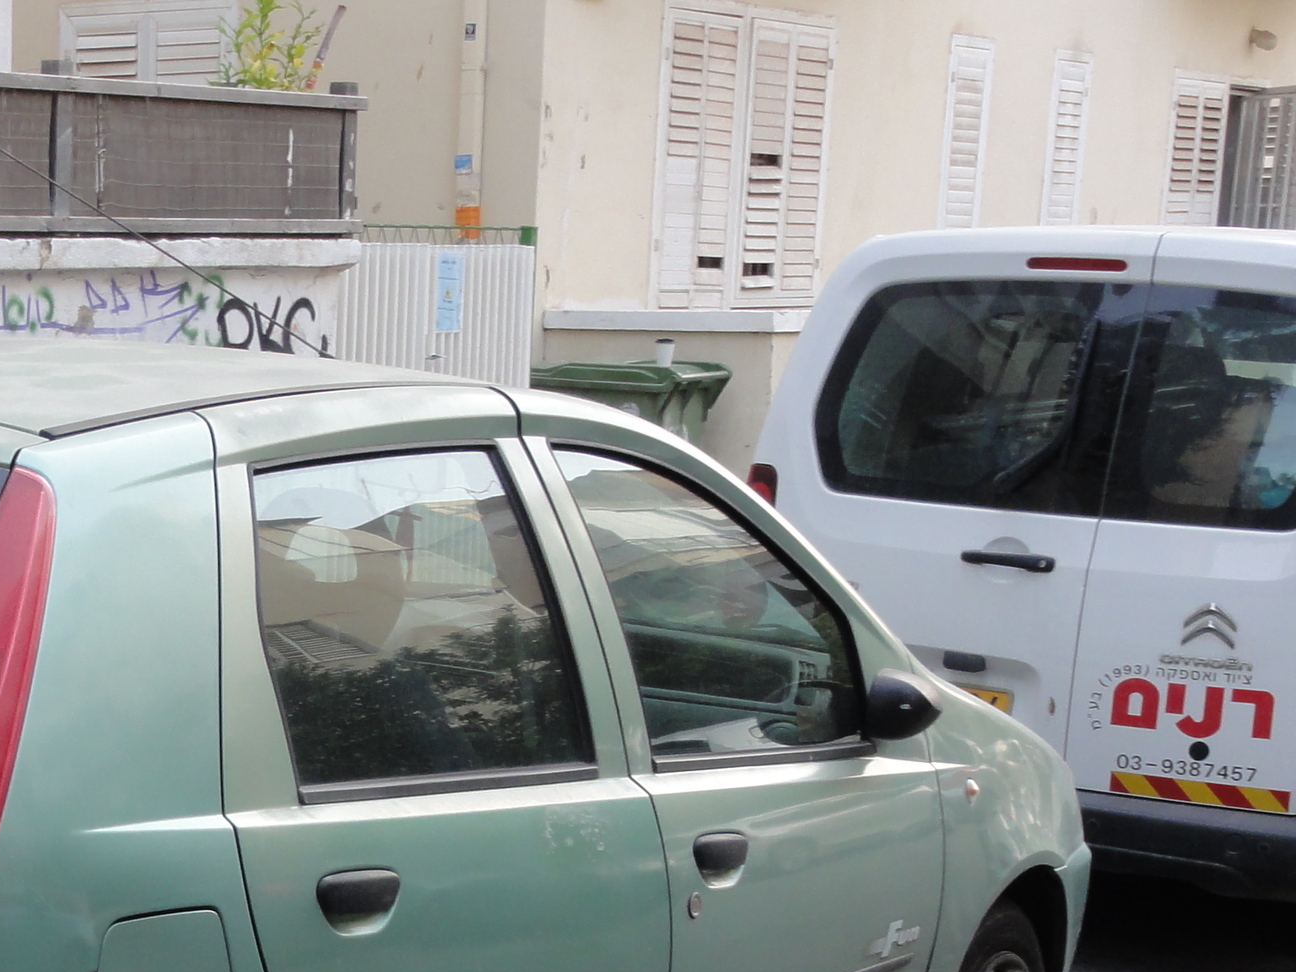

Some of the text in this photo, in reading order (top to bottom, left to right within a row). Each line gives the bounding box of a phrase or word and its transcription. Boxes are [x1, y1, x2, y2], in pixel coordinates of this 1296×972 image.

[1098, 664, 1150, 688] (1993)
[1155, 667, 1217, 682] ואספקה
[1223, 671, 1254, 686] ציוד
[1110, 677, 1275, 740] רנים
[1116, 754, 1257, 782] 03-9387457
